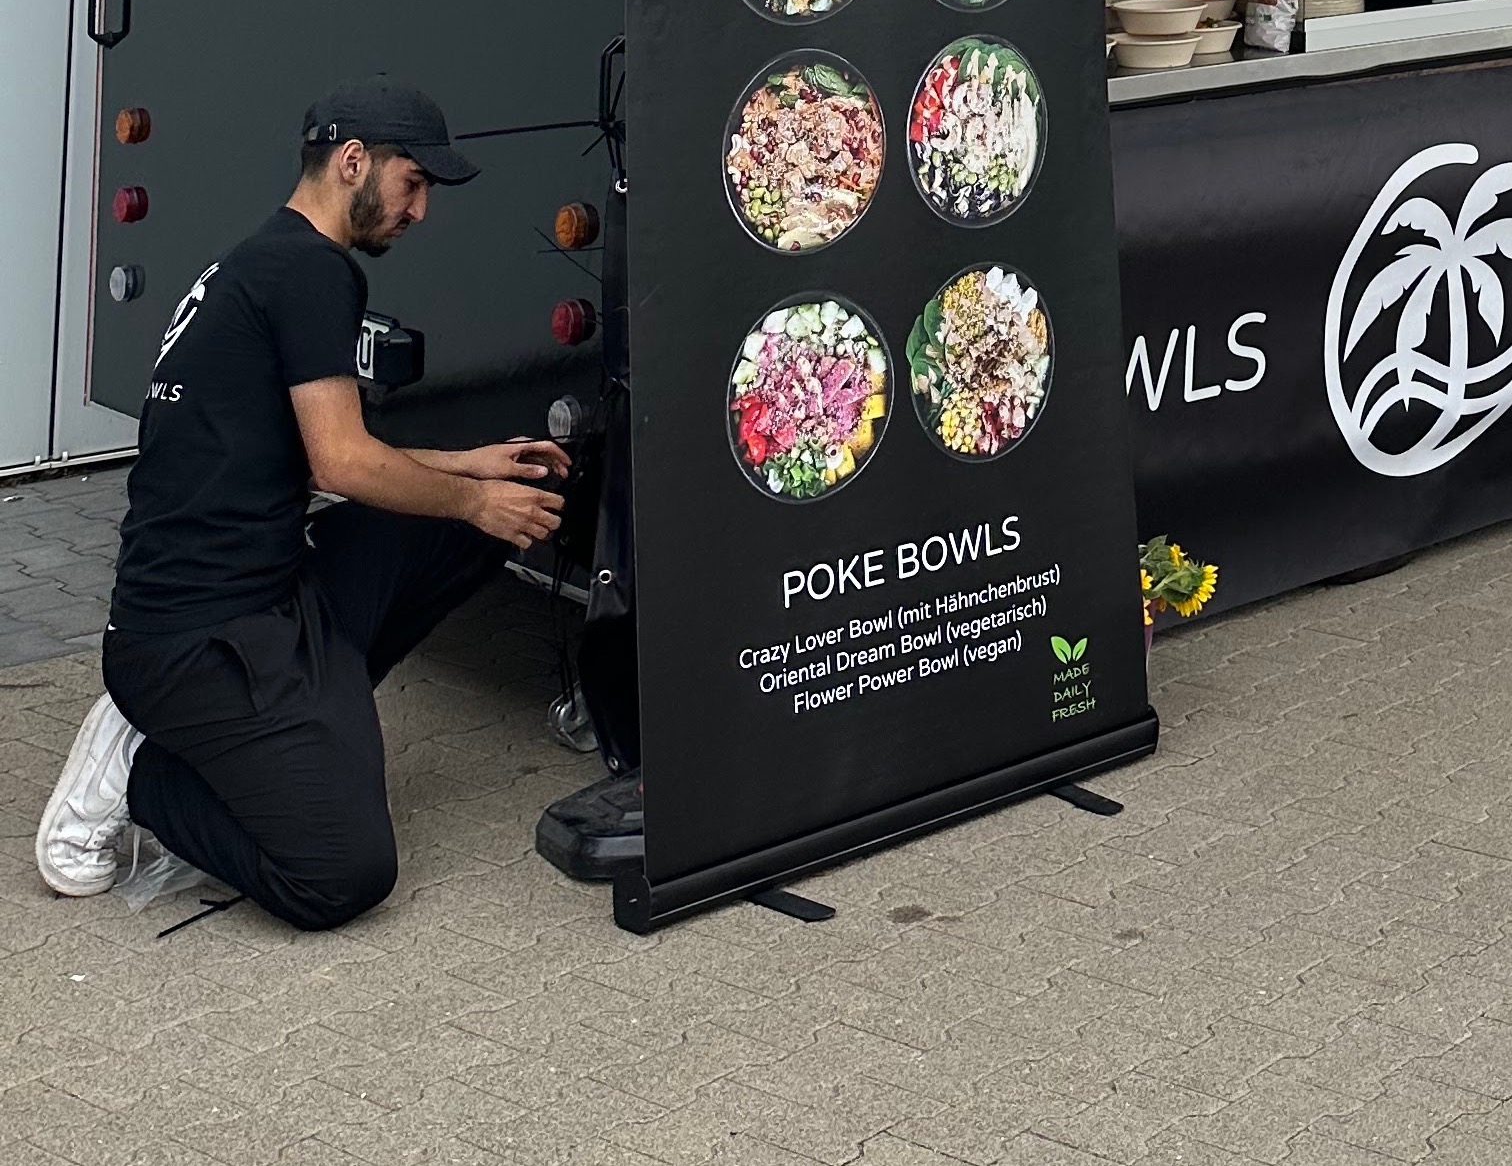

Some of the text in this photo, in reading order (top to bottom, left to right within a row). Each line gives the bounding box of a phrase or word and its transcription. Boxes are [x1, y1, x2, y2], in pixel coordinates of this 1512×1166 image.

[145, 381, 184, 402] WLS
[1125, 311, 1267, 412] WLS
[783, 515, 1022, 610] POKE BOWLS
[738, 563, 1061, 670] Crazy Lover Bowl (mit Hähnchenbrust)
[759, 594, 1048, 694] Oriental Dream Bowl (vegetarisch)
[793, 629, 1023, 715] Flower Power Bowl (vegan)
[1051, 697, 1097, 723] FRESH
[1053, 662, 1091, 686] MADE
[1053, 680, 1092, 703] DAILY
